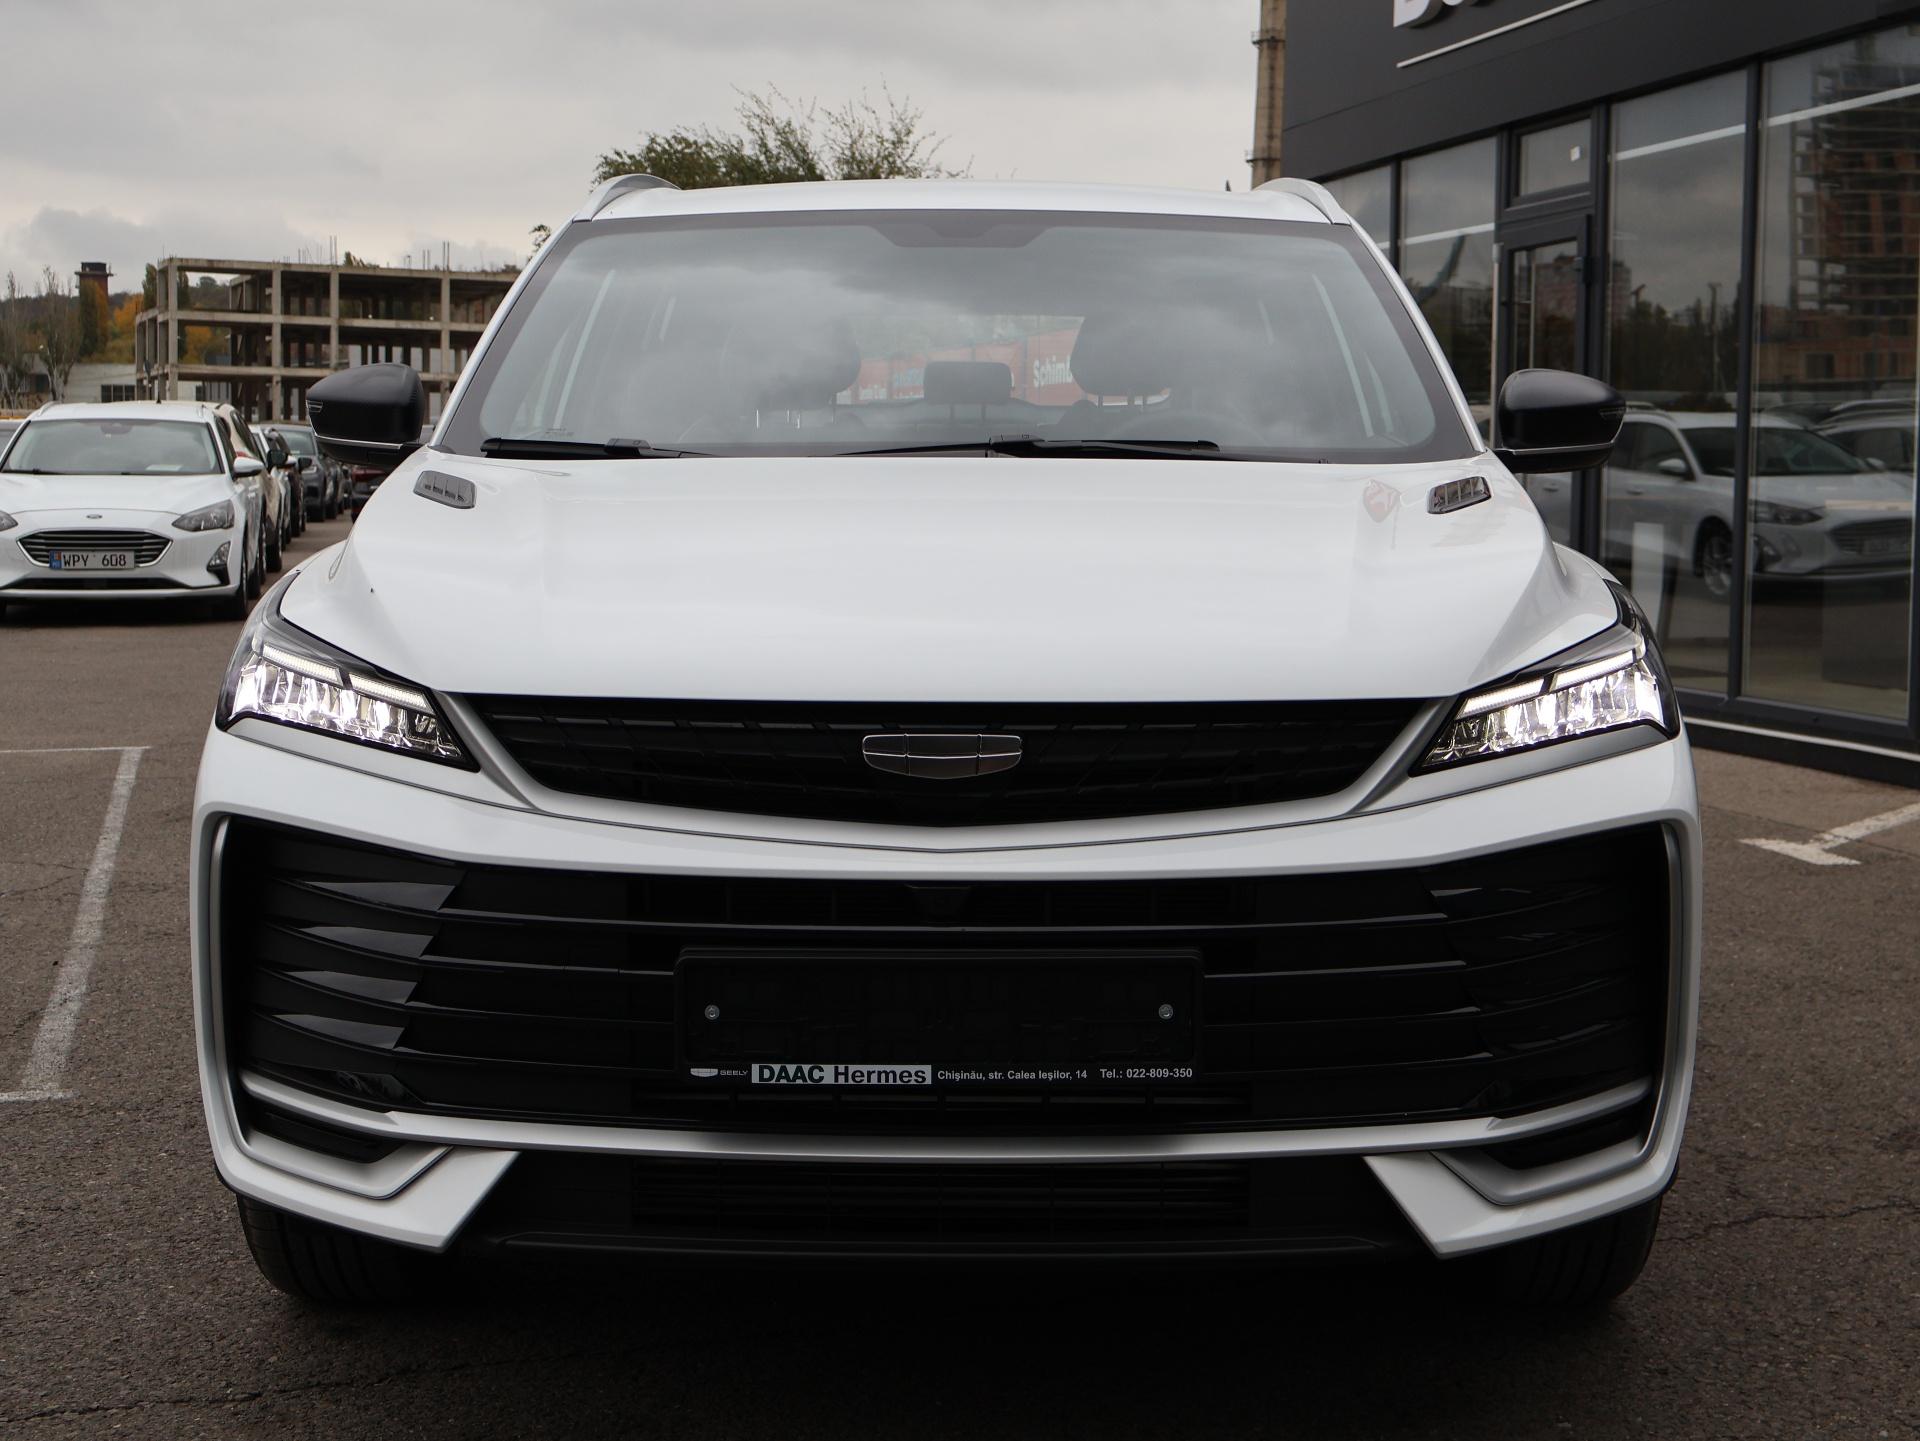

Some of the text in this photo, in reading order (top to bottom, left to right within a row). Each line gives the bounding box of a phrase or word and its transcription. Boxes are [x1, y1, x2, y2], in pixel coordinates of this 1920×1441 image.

[62, 554, 89, 567] WPY
[101, 554, 127, 567] 608
[758, 1064, 825, 1084] DAAC
[833, 1065, 927, 1084] Hermes
[988, 1071, 1005, 1080] str.
[1007, 1070, 1036, 1080] Calea
[1075, 1069, 1088, 1079] 14
[1099, 1068, 1123, 1079] Tel.:
[1126, 1068, 1193, 1079] 022-809-350
